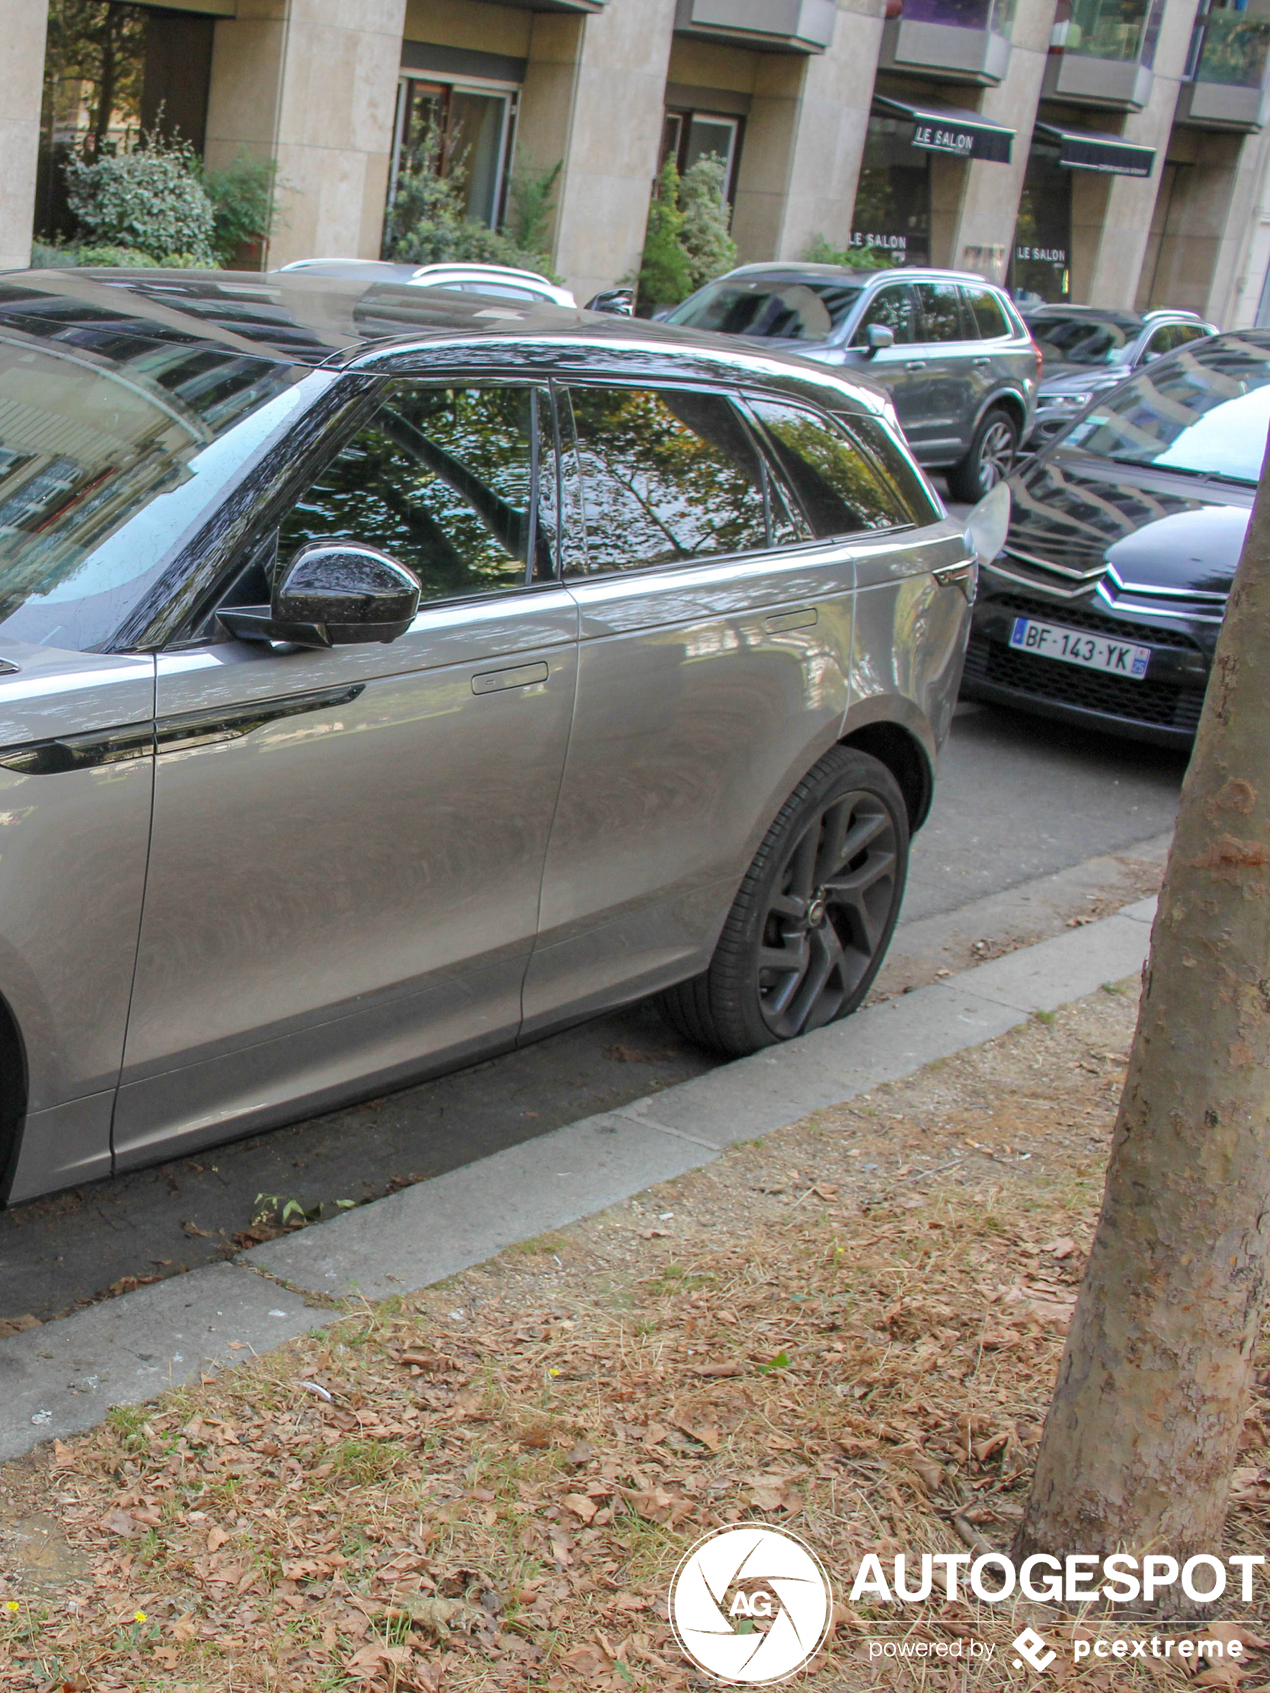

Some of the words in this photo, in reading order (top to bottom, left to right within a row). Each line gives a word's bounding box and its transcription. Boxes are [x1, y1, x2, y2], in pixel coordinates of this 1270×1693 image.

[914, 127, 932, 144] LE
[933, 130, 973, 149] SALON
[848, 232, 862, 246] LE
[864, 233, 906, 250] SALON
[1017, 246, 1031, 259] LE
[1032, 248, 1065, 261] SALON
[1026, 626, 1130, 670] BF-143-YK
